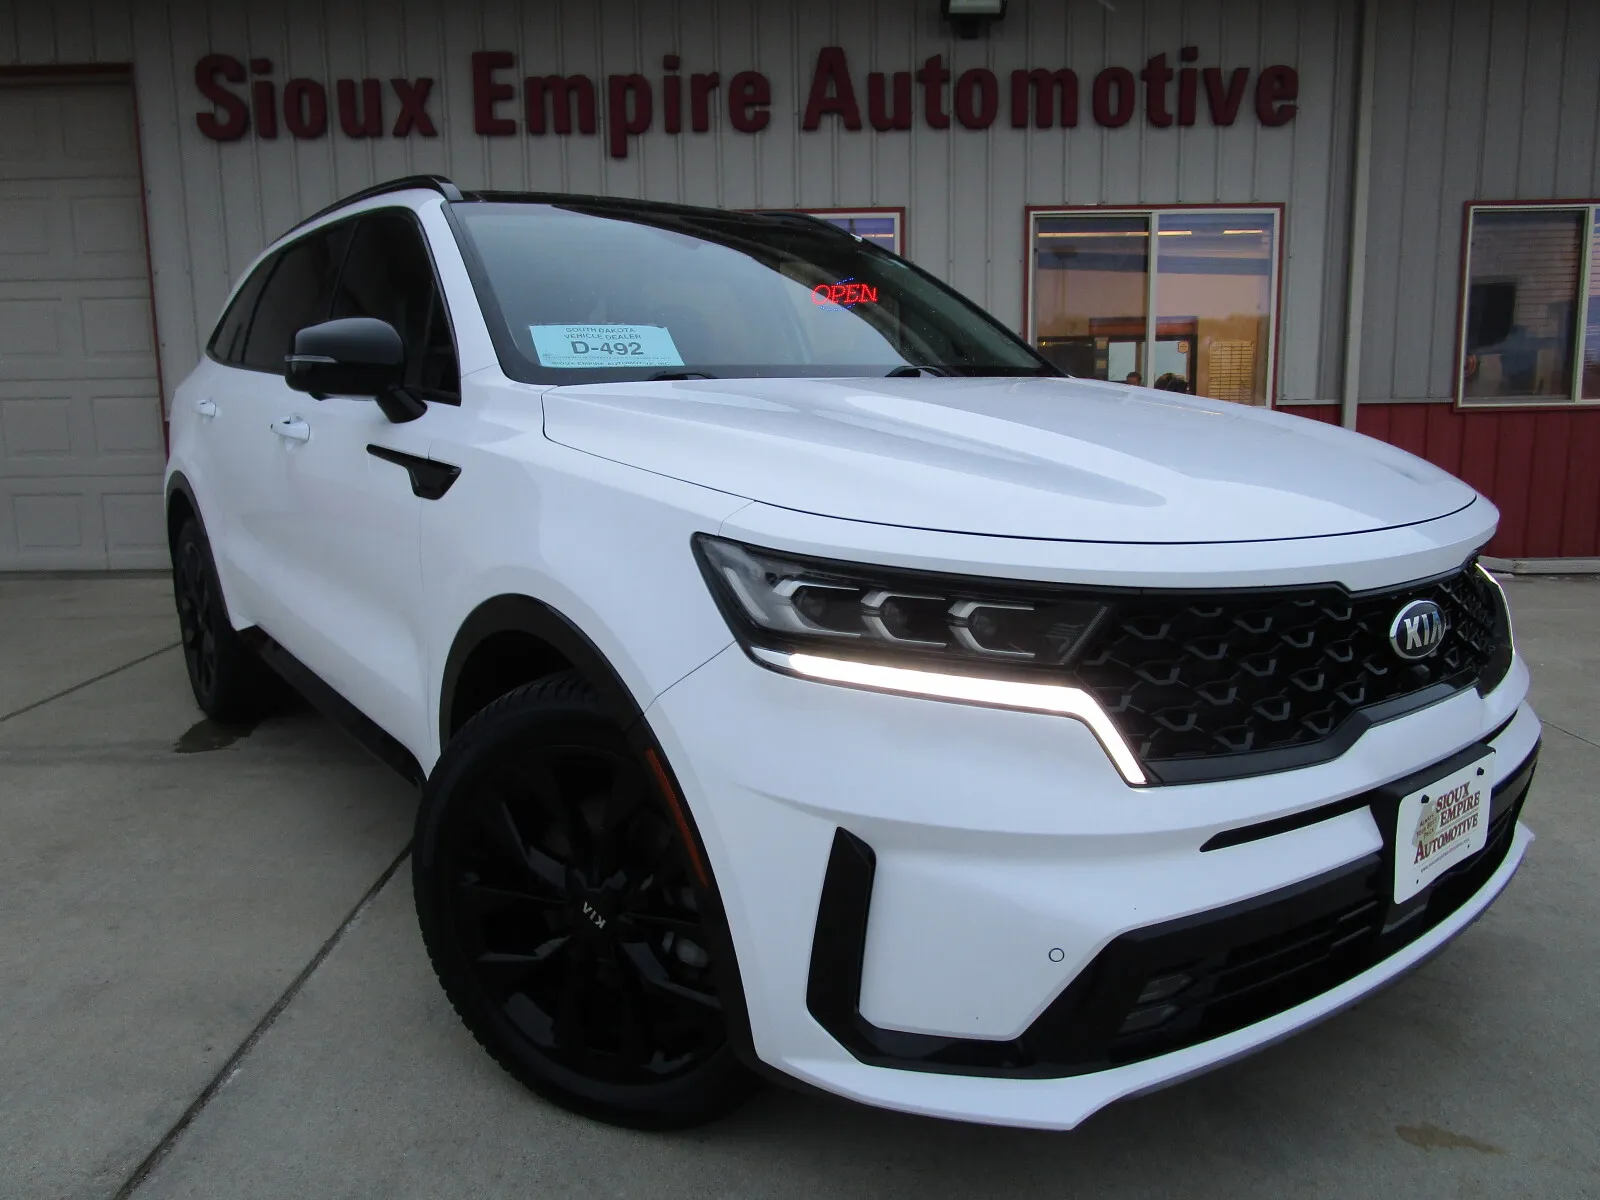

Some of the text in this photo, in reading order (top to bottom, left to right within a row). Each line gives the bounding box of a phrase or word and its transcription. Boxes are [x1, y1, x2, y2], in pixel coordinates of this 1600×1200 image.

[194, 46, 1299, 158] Sioux Empire Automotive
[811, 284, 878, 305] OPEN
[571, 341, 644, 356] D-492
[1404, 610, 1441, 650] KIA
[1435, 781, 1471, 813] SIOUX
[1439, 790, 1481, 828] EMPIRE
[1413, 812, 1479, 865] AUTOMOTIVE
[583, 900, 606, 929] KIA
